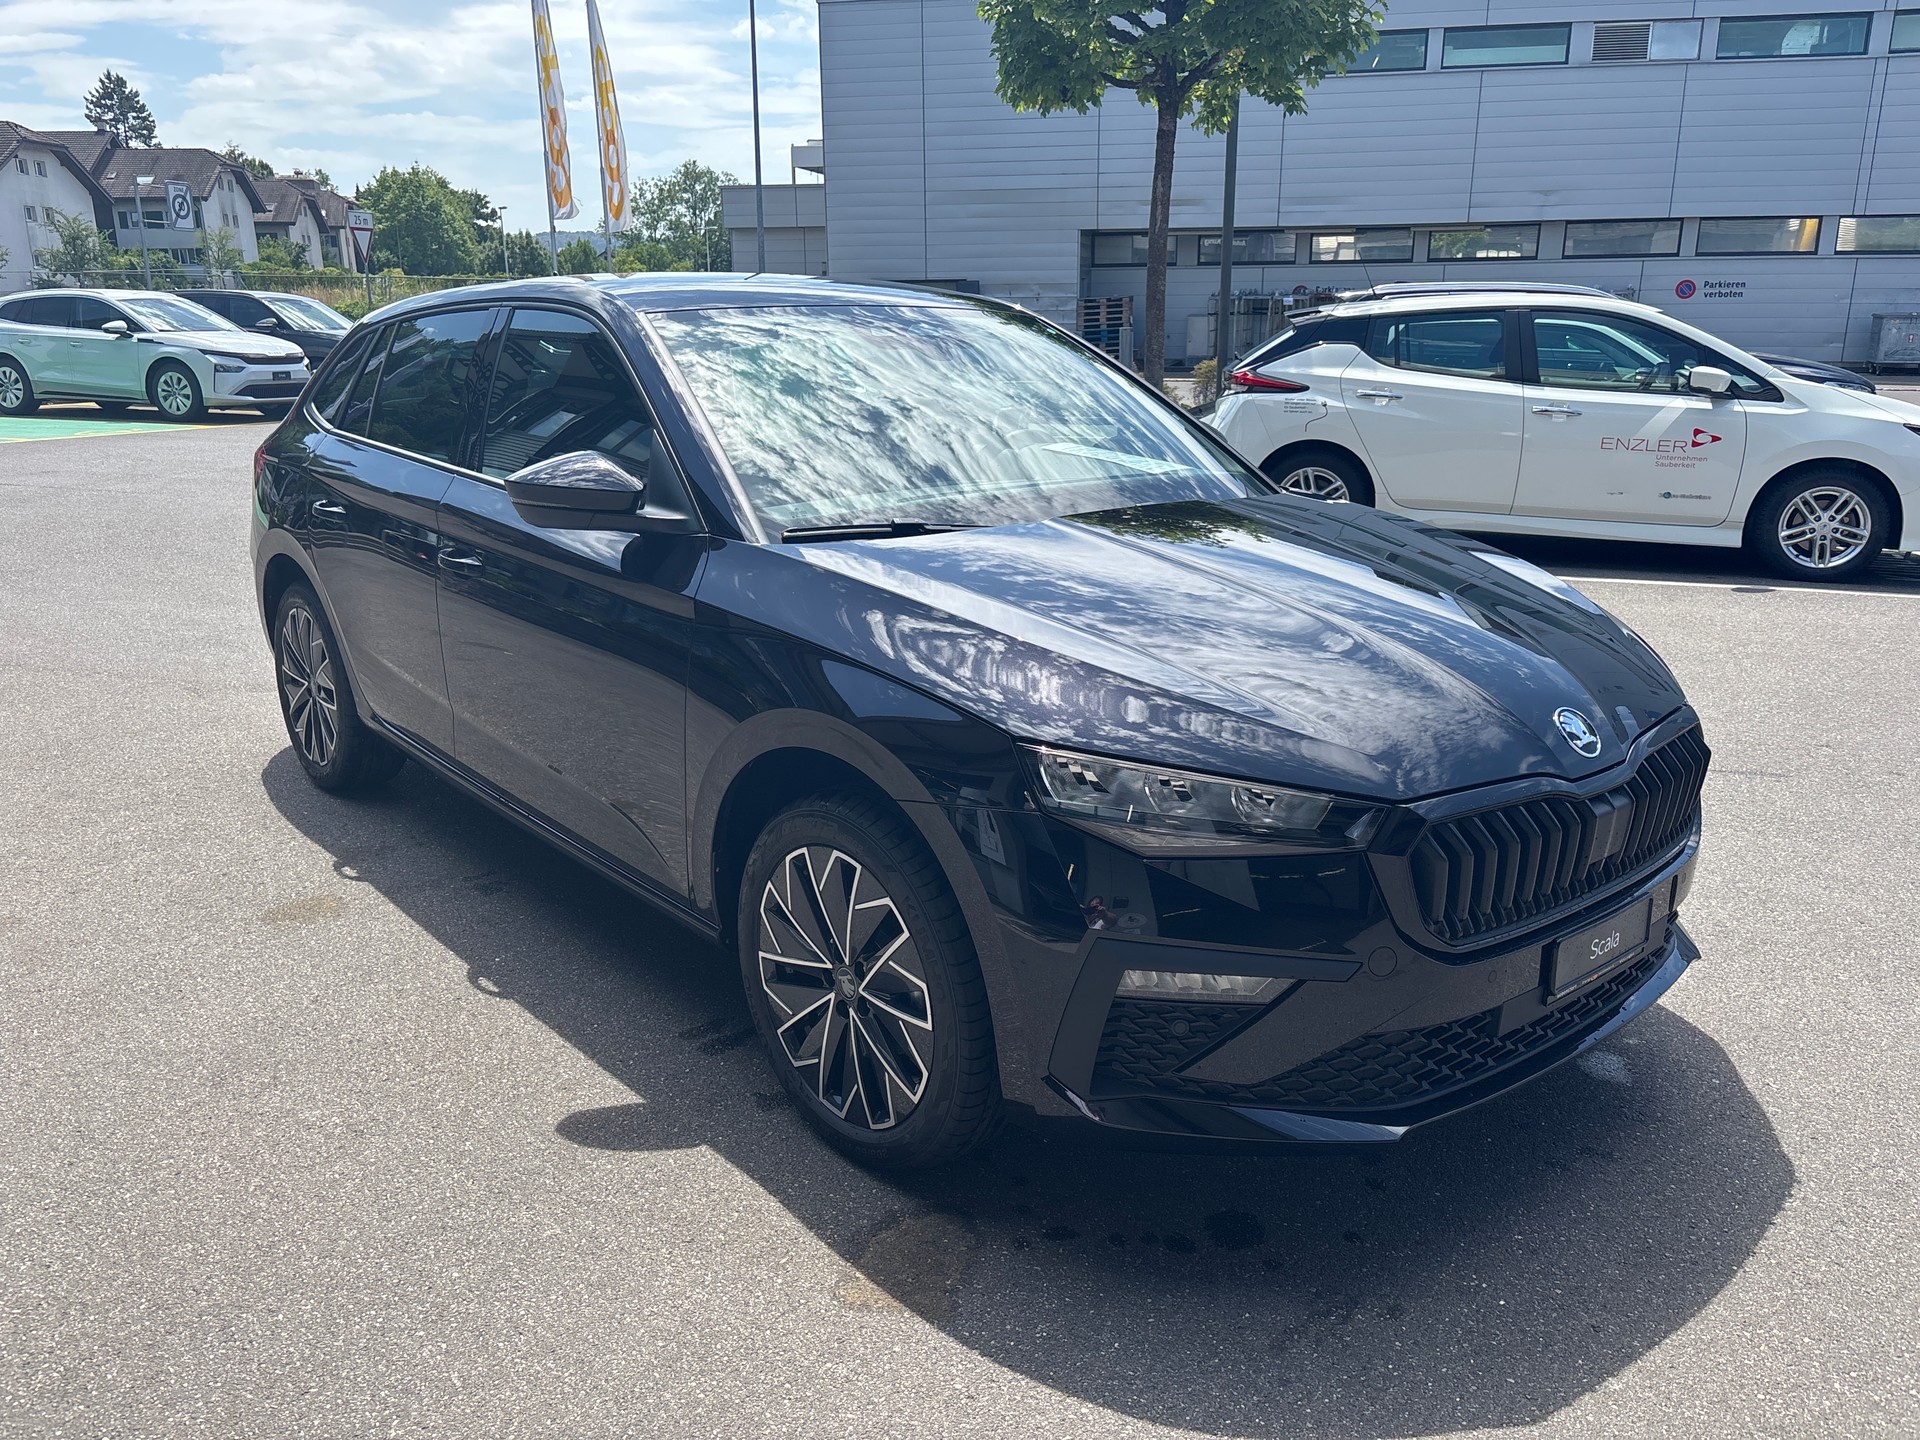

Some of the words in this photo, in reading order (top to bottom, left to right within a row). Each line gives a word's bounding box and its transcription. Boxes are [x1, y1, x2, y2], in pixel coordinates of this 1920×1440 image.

[595, 45, 625, 221] coop
[177, 201, 185, 212] 30
[354, 214, 362, 225] 25
[362, 218, 369, 226] m
[1703, 280, 1746, 289] Parkieren
[1703, 289, 1744, 298] verboten
[1600, 437, 1688, 453] ENZLER
[1655, 454, 1708, 463] Unternehmen
[1654, 460, 1696, 469] Sauberkeit
[1589, 930, 1620, 960] Scala
